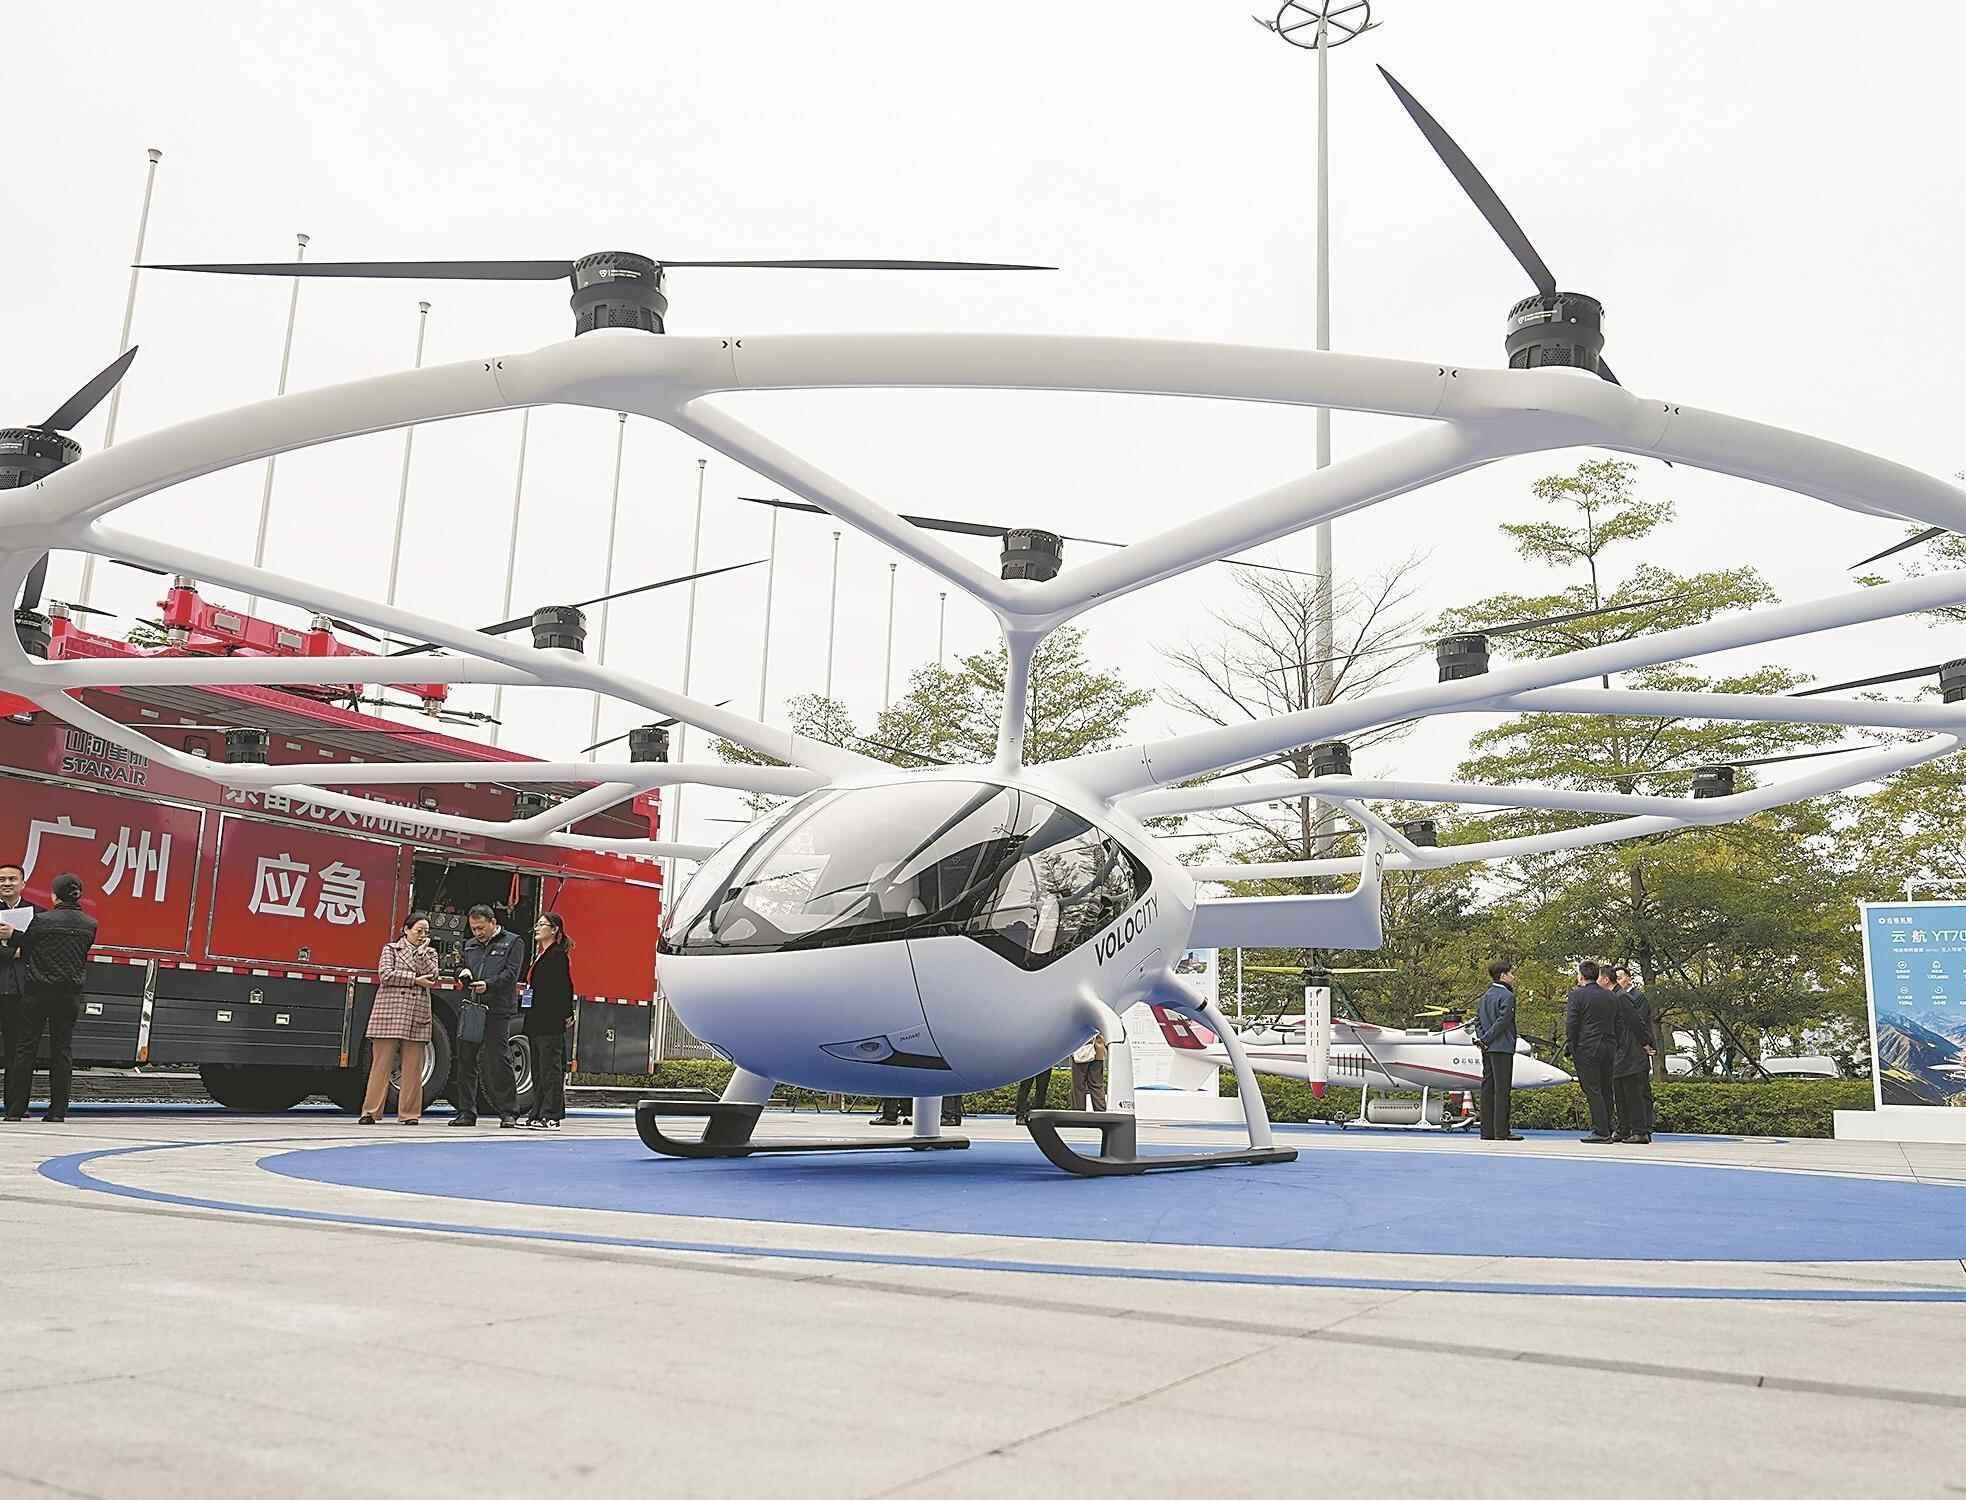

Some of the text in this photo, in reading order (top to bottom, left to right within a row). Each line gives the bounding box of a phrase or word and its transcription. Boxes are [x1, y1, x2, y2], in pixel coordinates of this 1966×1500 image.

[62, 756, 147, 786] STARAIR
[22, 815, 367, 925] 广州 应急
[1094, 887, 1158, 967] VOLOCITY
